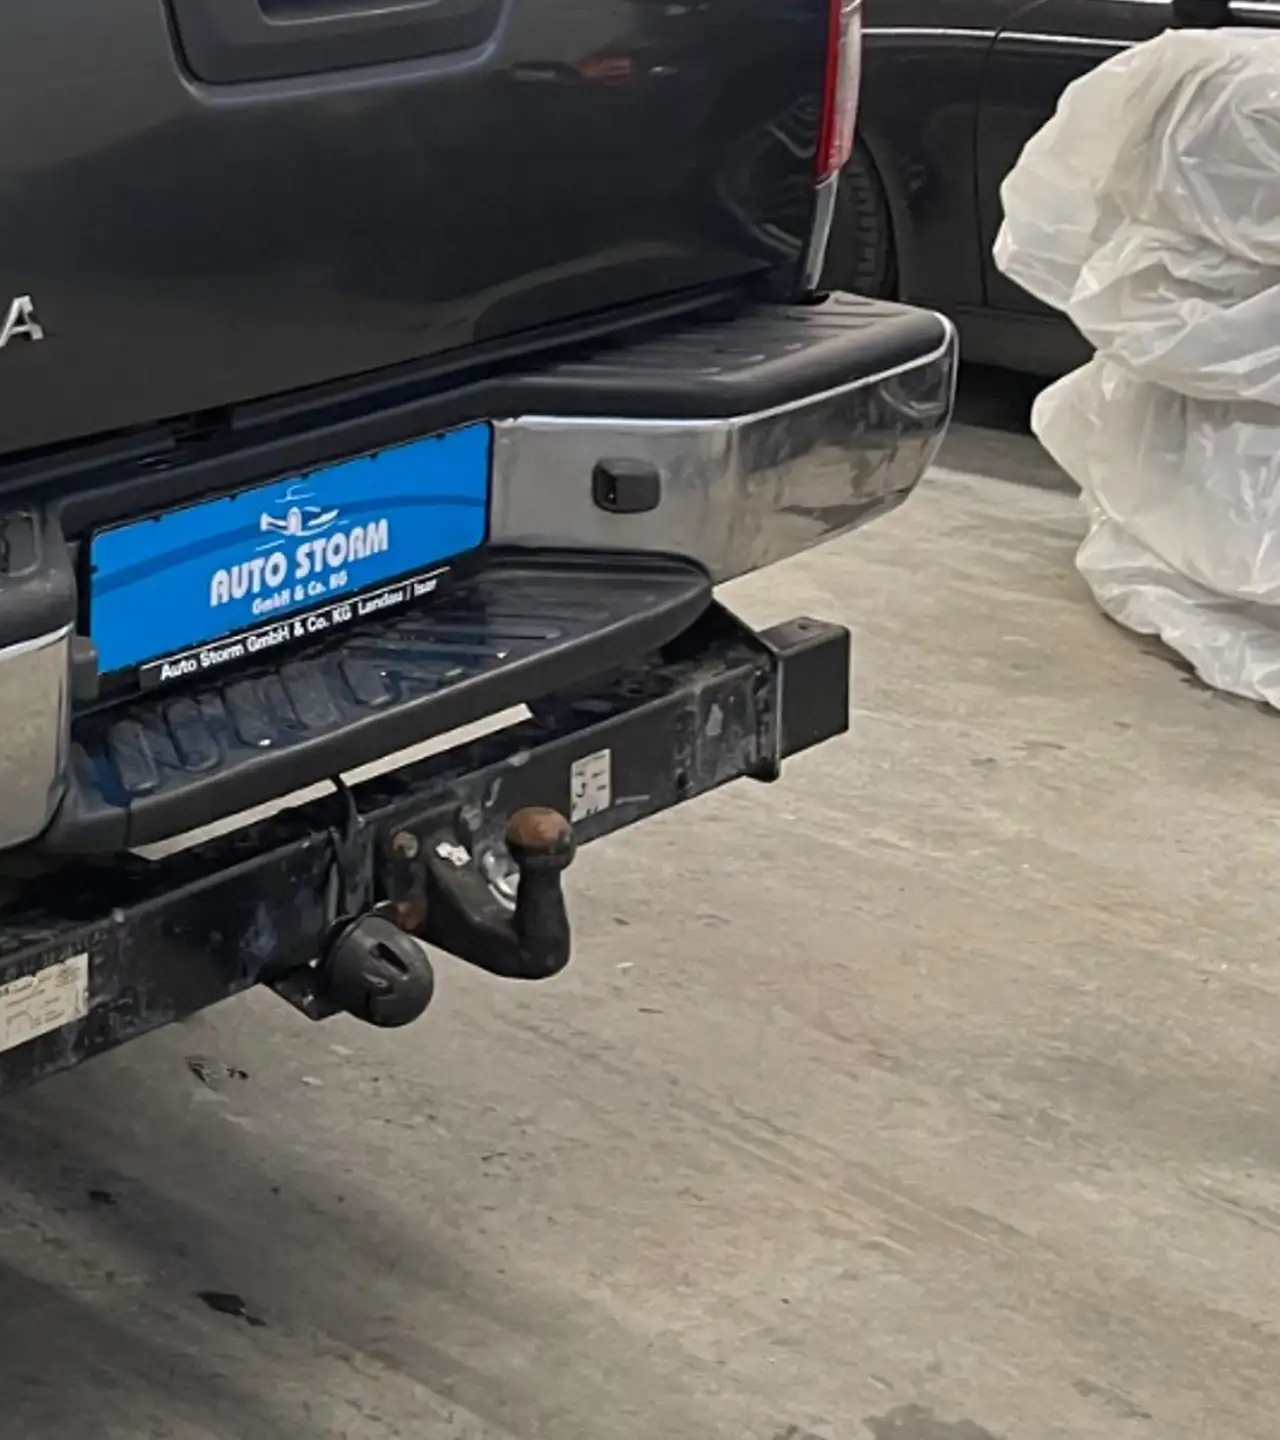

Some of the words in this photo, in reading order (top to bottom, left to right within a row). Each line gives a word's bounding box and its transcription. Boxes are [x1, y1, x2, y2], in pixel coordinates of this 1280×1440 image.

[210, 552, 288, 607] AUTO
[295, 518, 389, 580] STORM
[252, 588, 291, 615] GmbH
[294, 583, 305, 602] &
[160, 659, 197, 681] Auto
[199, 644, 245, 669] Storm
[246, 625, 290, 652] GmbH
[293, 621, 305, 637] &
[307, 615, 330, 632] Co.
[332, 605, 352, 624] KG
[358, 590, 403, 615] Landau
